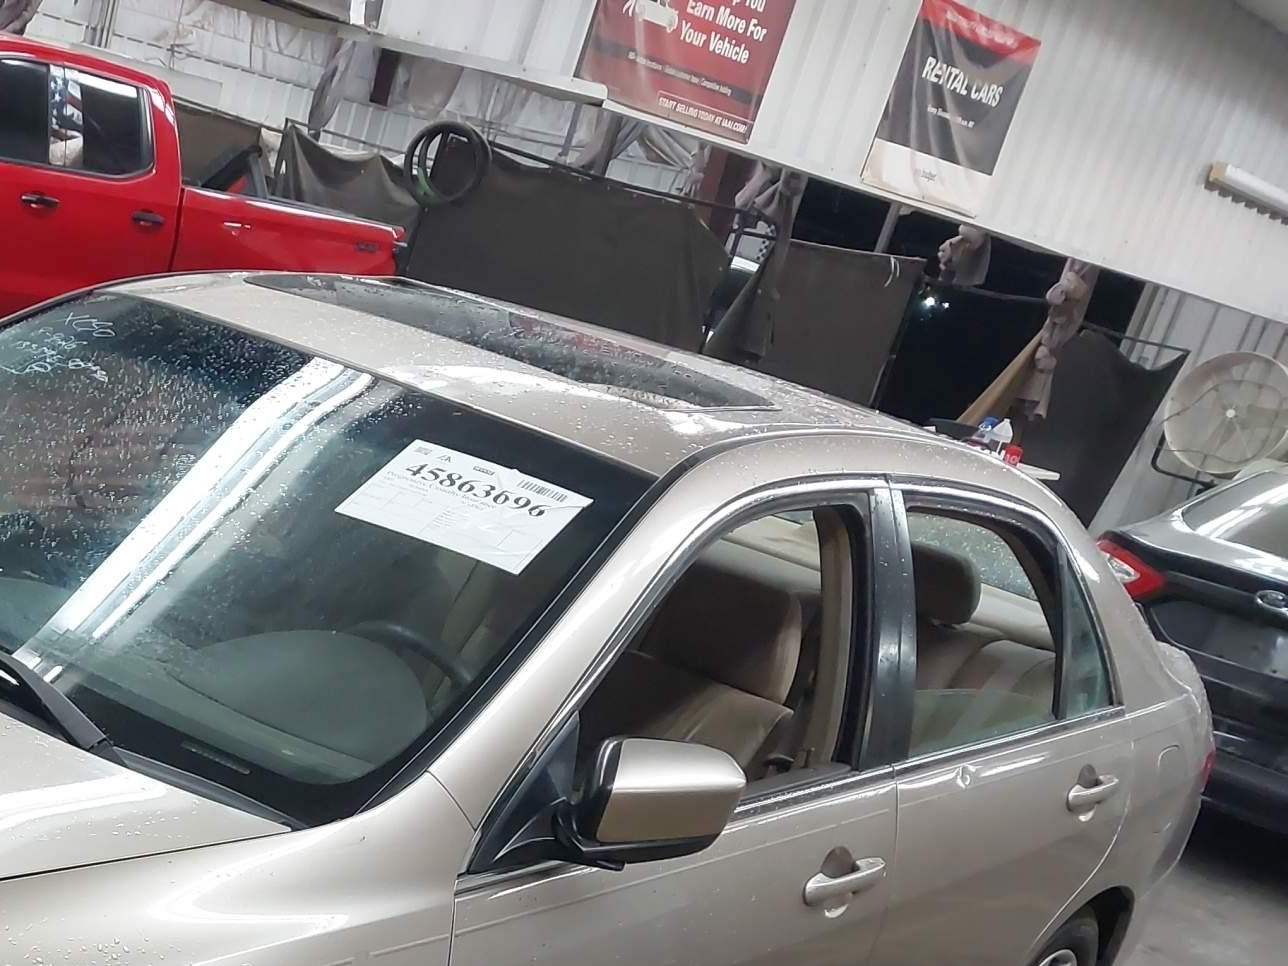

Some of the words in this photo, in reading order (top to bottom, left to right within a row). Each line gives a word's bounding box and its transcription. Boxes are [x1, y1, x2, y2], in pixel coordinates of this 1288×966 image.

[680, 20, 707, 47] Your
[709, 32, 750, 64] Vehicle
[686, 0, 715, 21] Earn
[716, 5, 746, 34] More
[747, 18, 767, 42] For
[921, 56, 968, 96] RENTAL
[970, 80, 1003, 107] CARS
[658, 97, 677, 110] START
[676, 103, 699, 118] SELLING
[697, 110, 716, 122] TODAY
[714, 116, 722, 126] AT
[405, 463, 551, 517] 45863696
